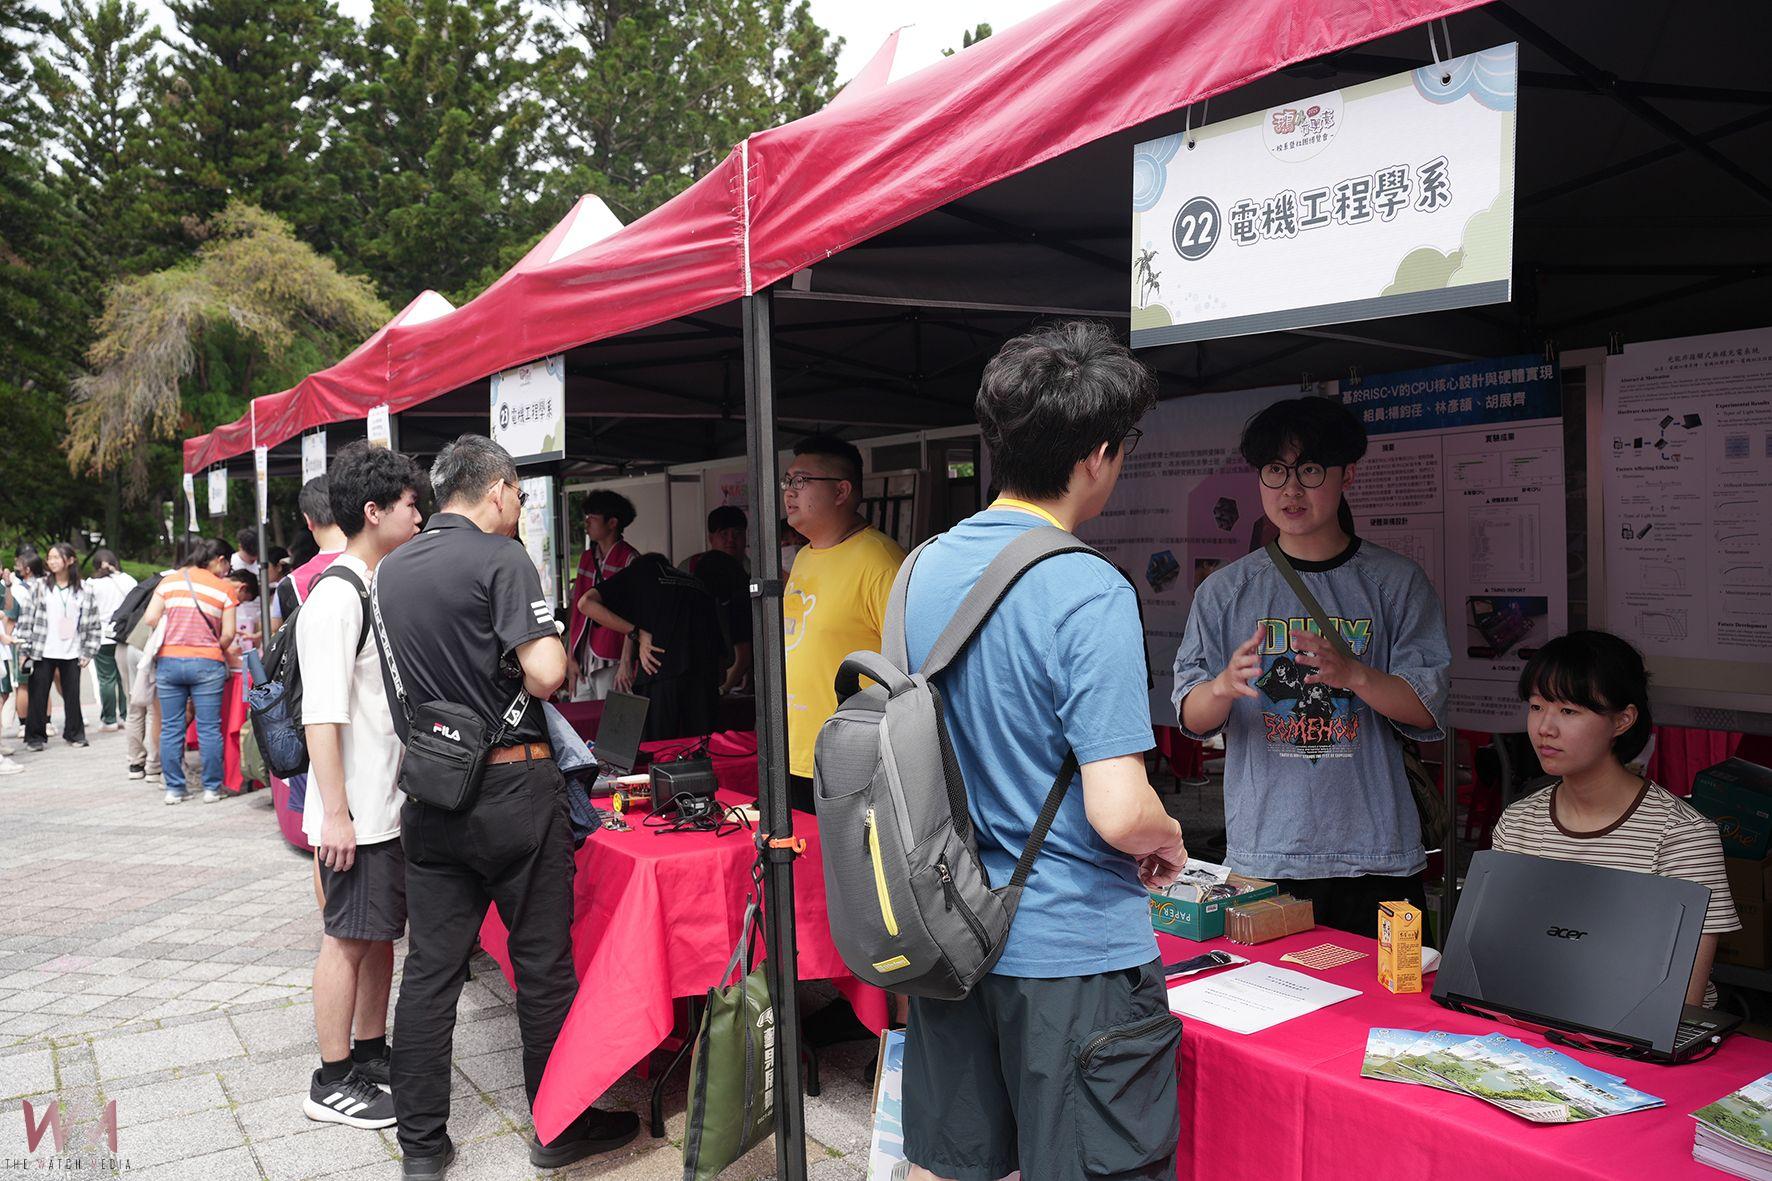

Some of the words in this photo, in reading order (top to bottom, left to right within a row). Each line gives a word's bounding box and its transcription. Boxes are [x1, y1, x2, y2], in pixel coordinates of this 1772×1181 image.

[1181, 211, 1214, 248] 22
[1229, 156, 1453, 247] 電機工程學系
[432, 721, 461, 742] FILA
[1163, 907, 1191, 922] PAPER
[1546, 926, 1588, 940] acer
